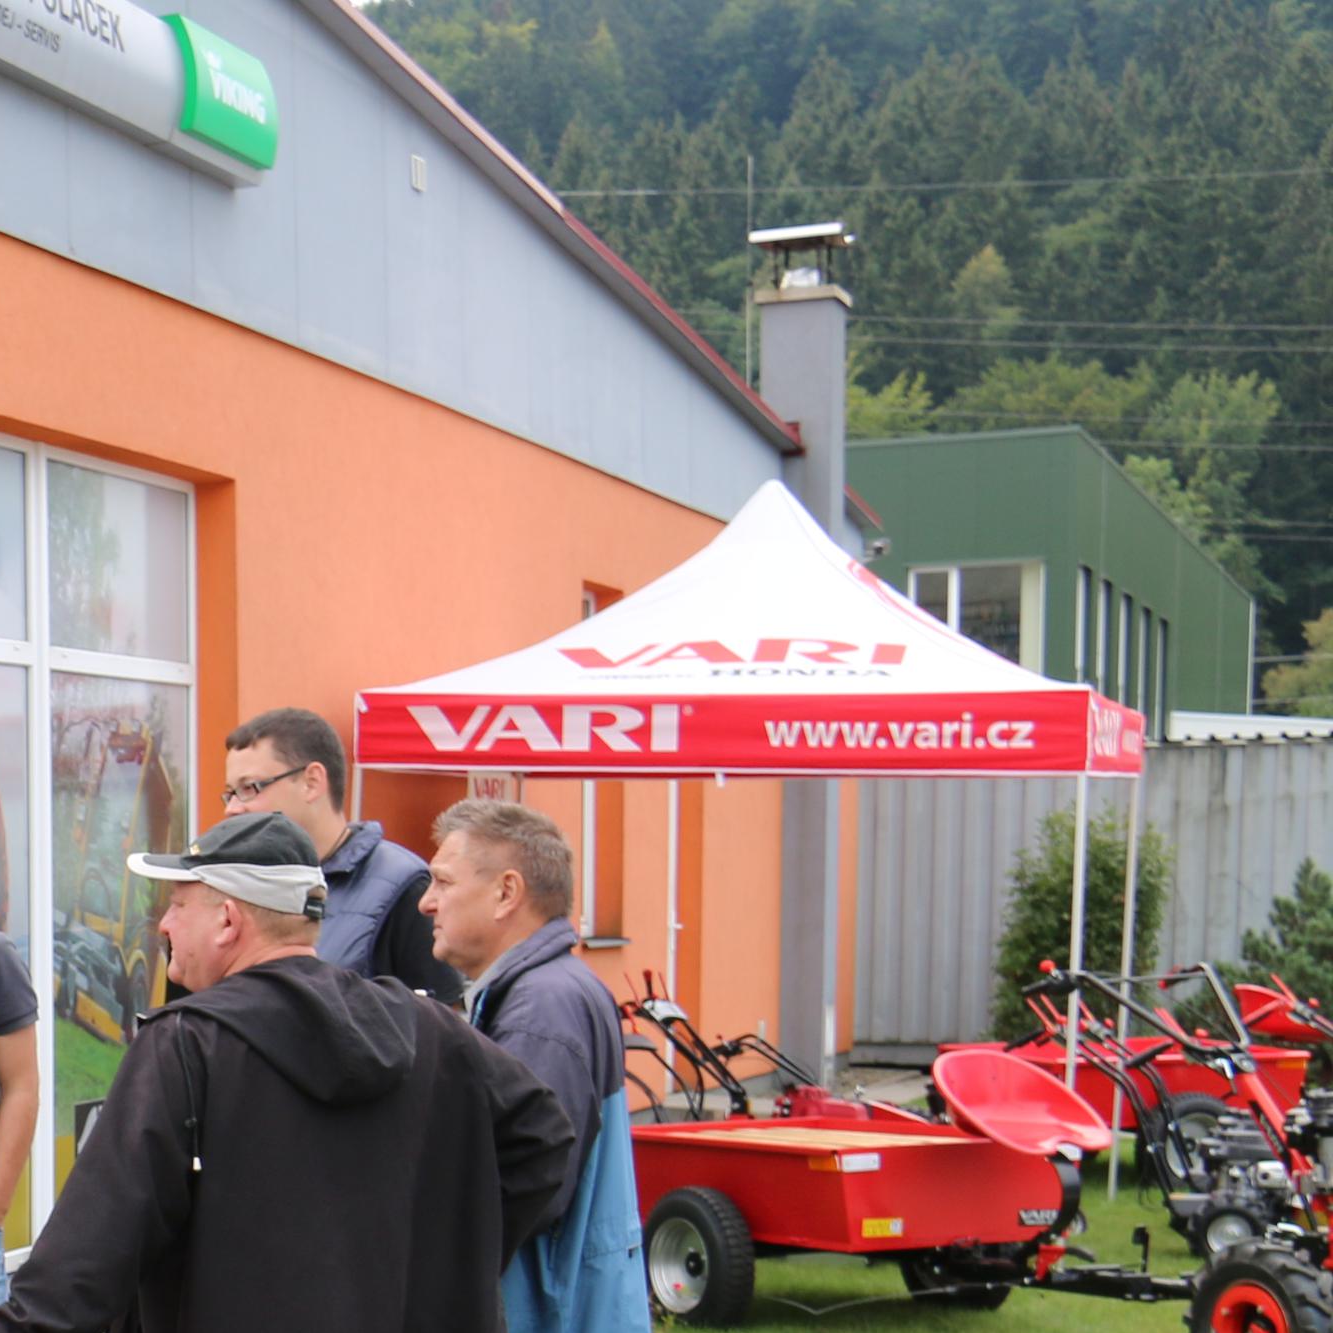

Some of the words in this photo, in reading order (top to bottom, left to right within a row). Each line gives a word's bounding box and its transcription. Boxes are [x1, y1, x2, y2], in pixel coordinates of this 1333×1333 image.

[208, 67, 268, 126] VIKING
[558, 638, 907, 669] VARI
[405, 703, 679, 752] VARI
[763, 712, 1035, 750] www.vari.cz
